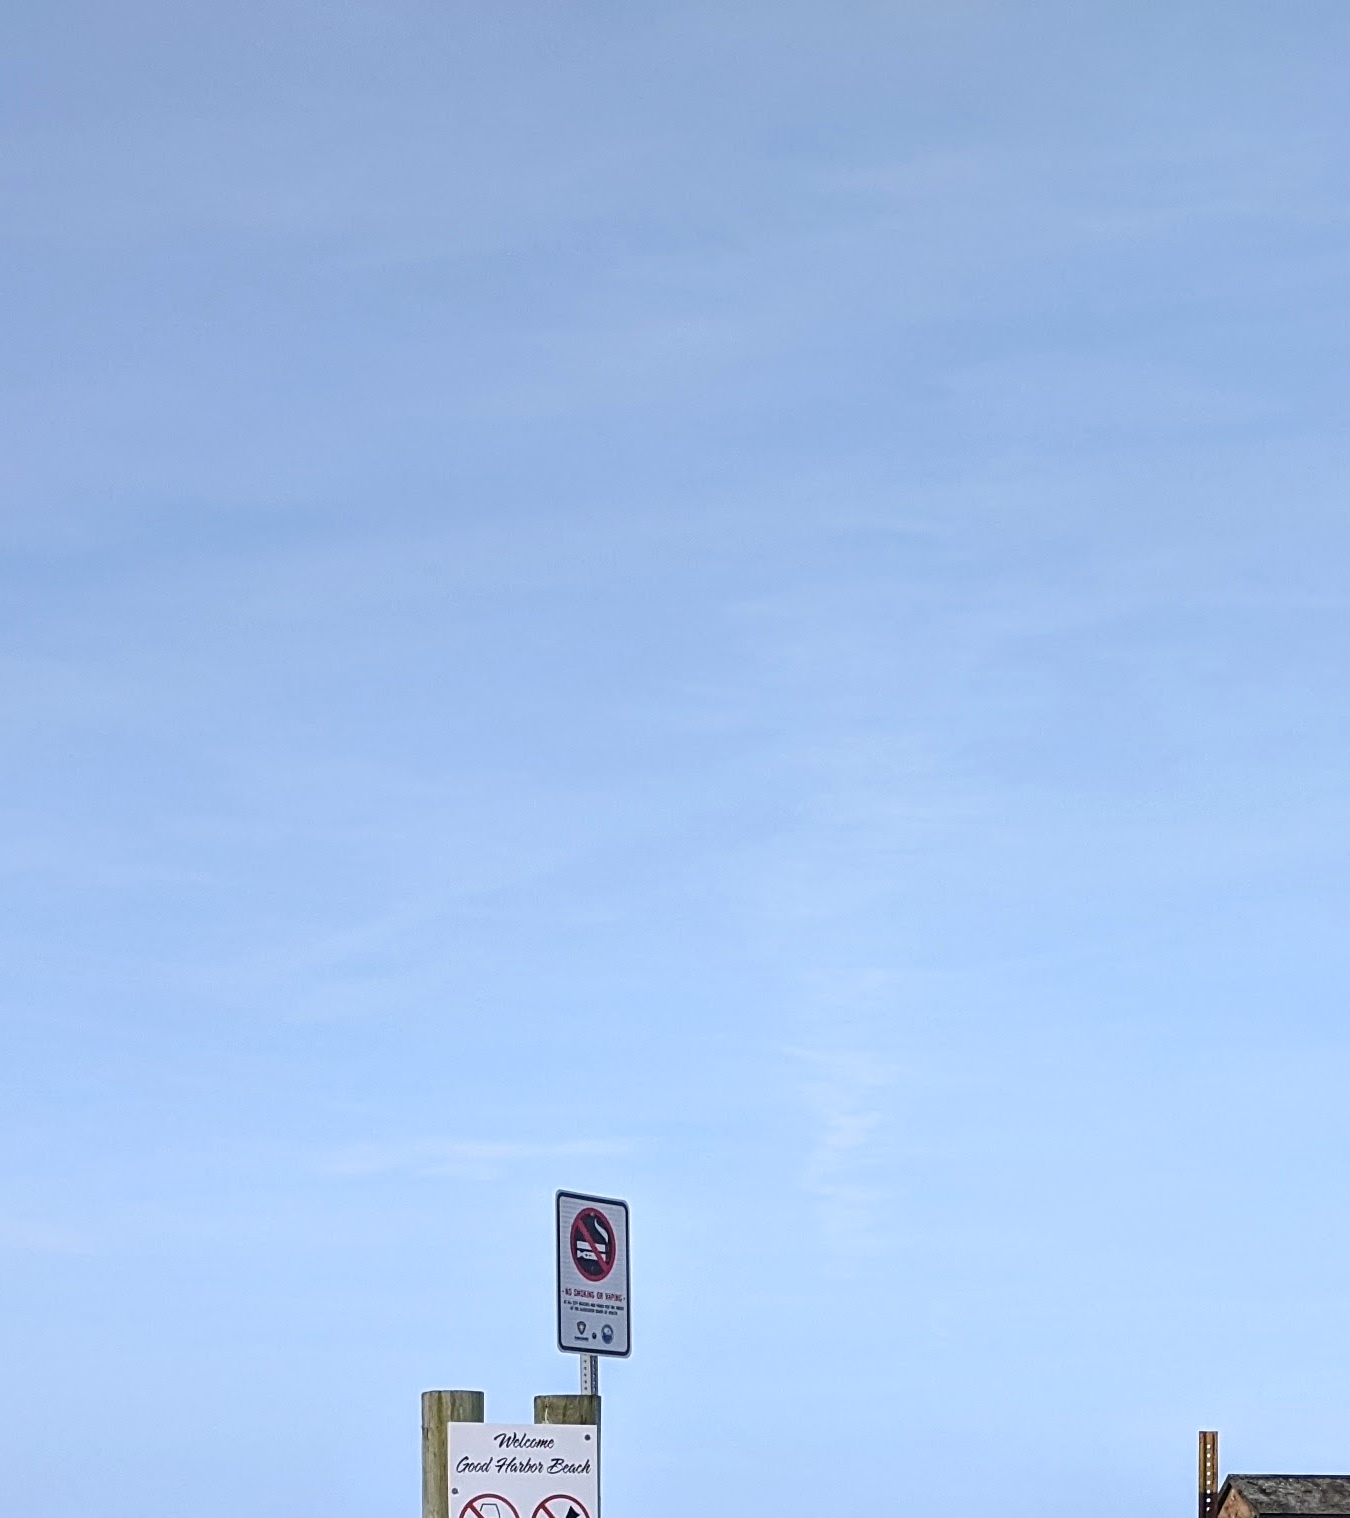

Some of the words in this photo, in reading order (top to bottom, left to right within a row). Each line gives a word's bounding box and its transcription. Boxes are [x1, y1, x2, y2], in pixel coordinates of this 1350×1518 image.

[574, 1289, 594, 1299] SMOKING
[605, 1293, 622, 1302] VAPING
[494, 1432, 554, 1449] Welcome
[456, 1456, 493, 1473] Good
[495, 1457, 543, 1474] Harbor
[547, 1458, 591, 1474] Beach
